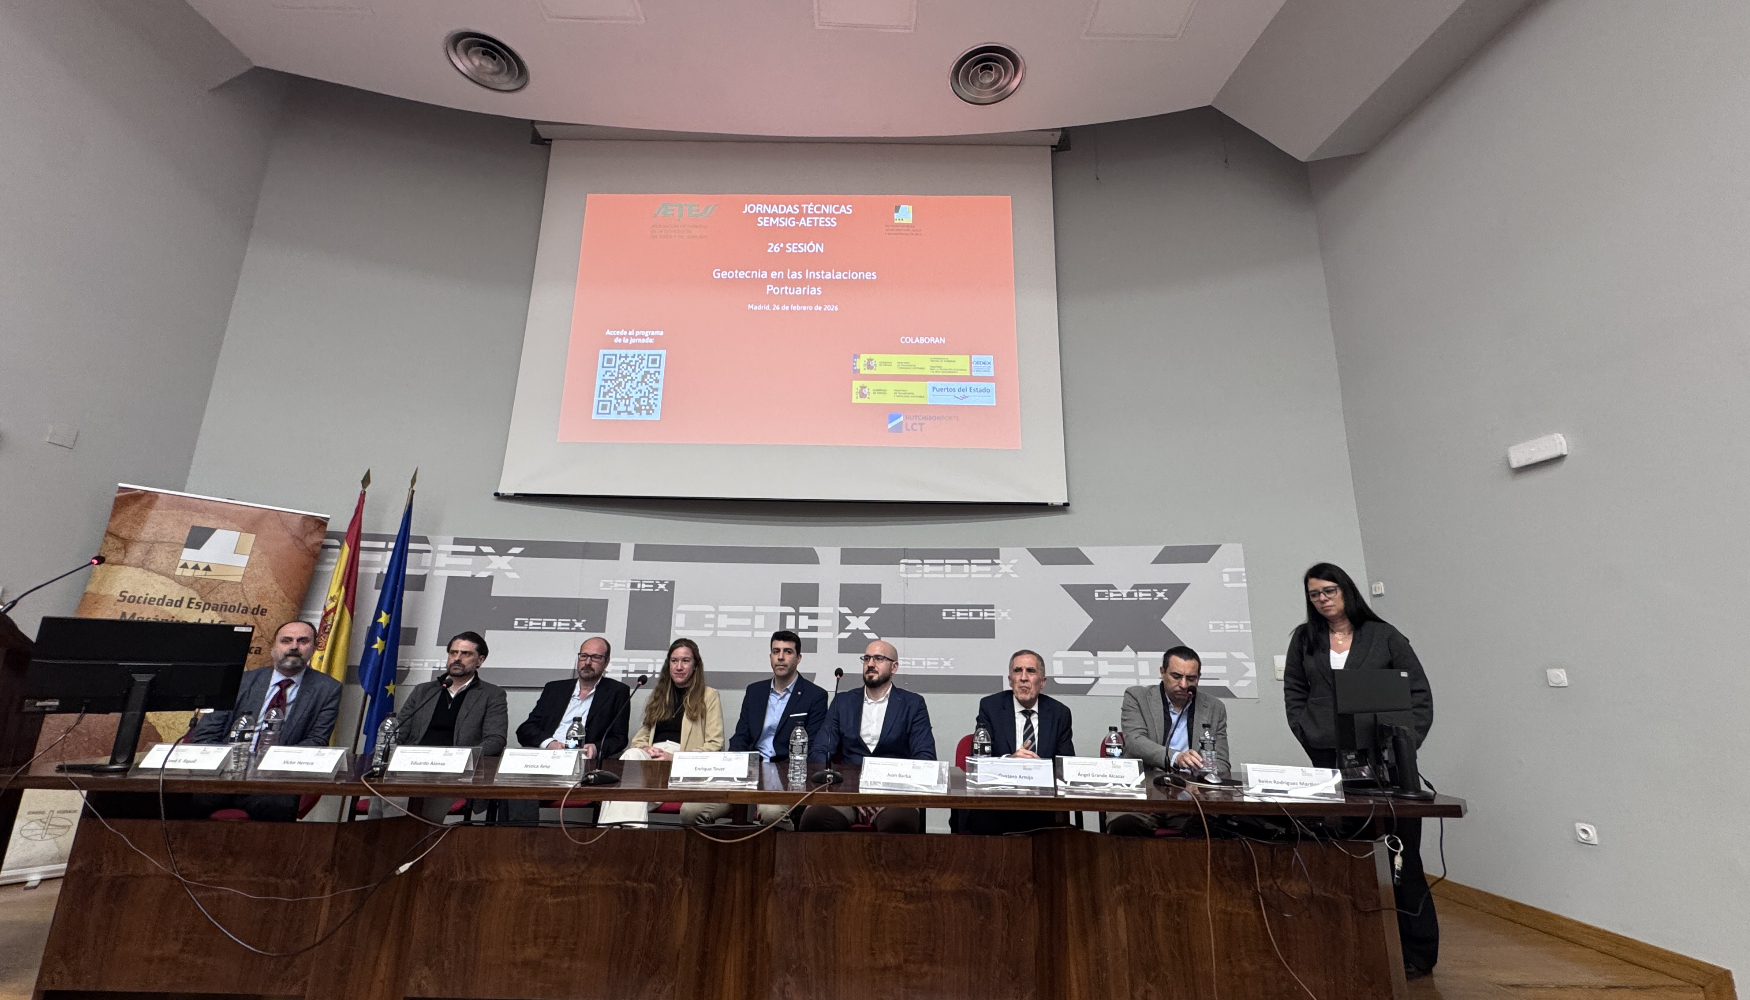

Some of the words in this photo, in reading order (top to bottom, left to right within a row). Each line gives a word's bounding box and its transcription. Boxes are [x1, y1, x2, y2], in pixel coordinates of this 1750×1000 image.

[742, 203, 800, 215] JORNADAS
[801, 202, 853, 215] TÉCNICAS
[756, 217, 837, 228] SEMSIG-AETESS
[785, 240, 824, 253] SESIÓN
[712, 268, 768, 280] Geotecnia
[770, 271, 784, 280] en
[787, 269, 803, 280] las
[805, 269, 877, 280] Instalaciones
[766, 284, 822, 296] Portuarias
[747, 303, 771, 312] Madrid,
[781, 304, 789, 312] de
[790, 304, 813, 312] febrero
[814, 304, 822, 312] de
[823, 304, 839, 312] 2026
[605, 328, 627, 336] Accede
[628, 328, 634, 336] al
[635, 329, 664, 337] programa
[629, 337, 655, 345] jornada:
[900, 336, 946, 344] COLABORAN
[905, 422, 925, 432] LCT
[900, 558, 1019, 578] CEDEX
[600, 579, 669, 592] CEDEX
[1094, 588, 1169, 601] CEDEX
[117, 590, 184, 609] Sociedad
[186, 596, 249, 614] Española
[251, 604, 268, 617] de
[942, 608, 1012, 620] CEDEX
[513, 617, 587, 631] CEDEX
[675, 604, 880, 639] CEDEX
[898, 656, 955, 669] EDEX
